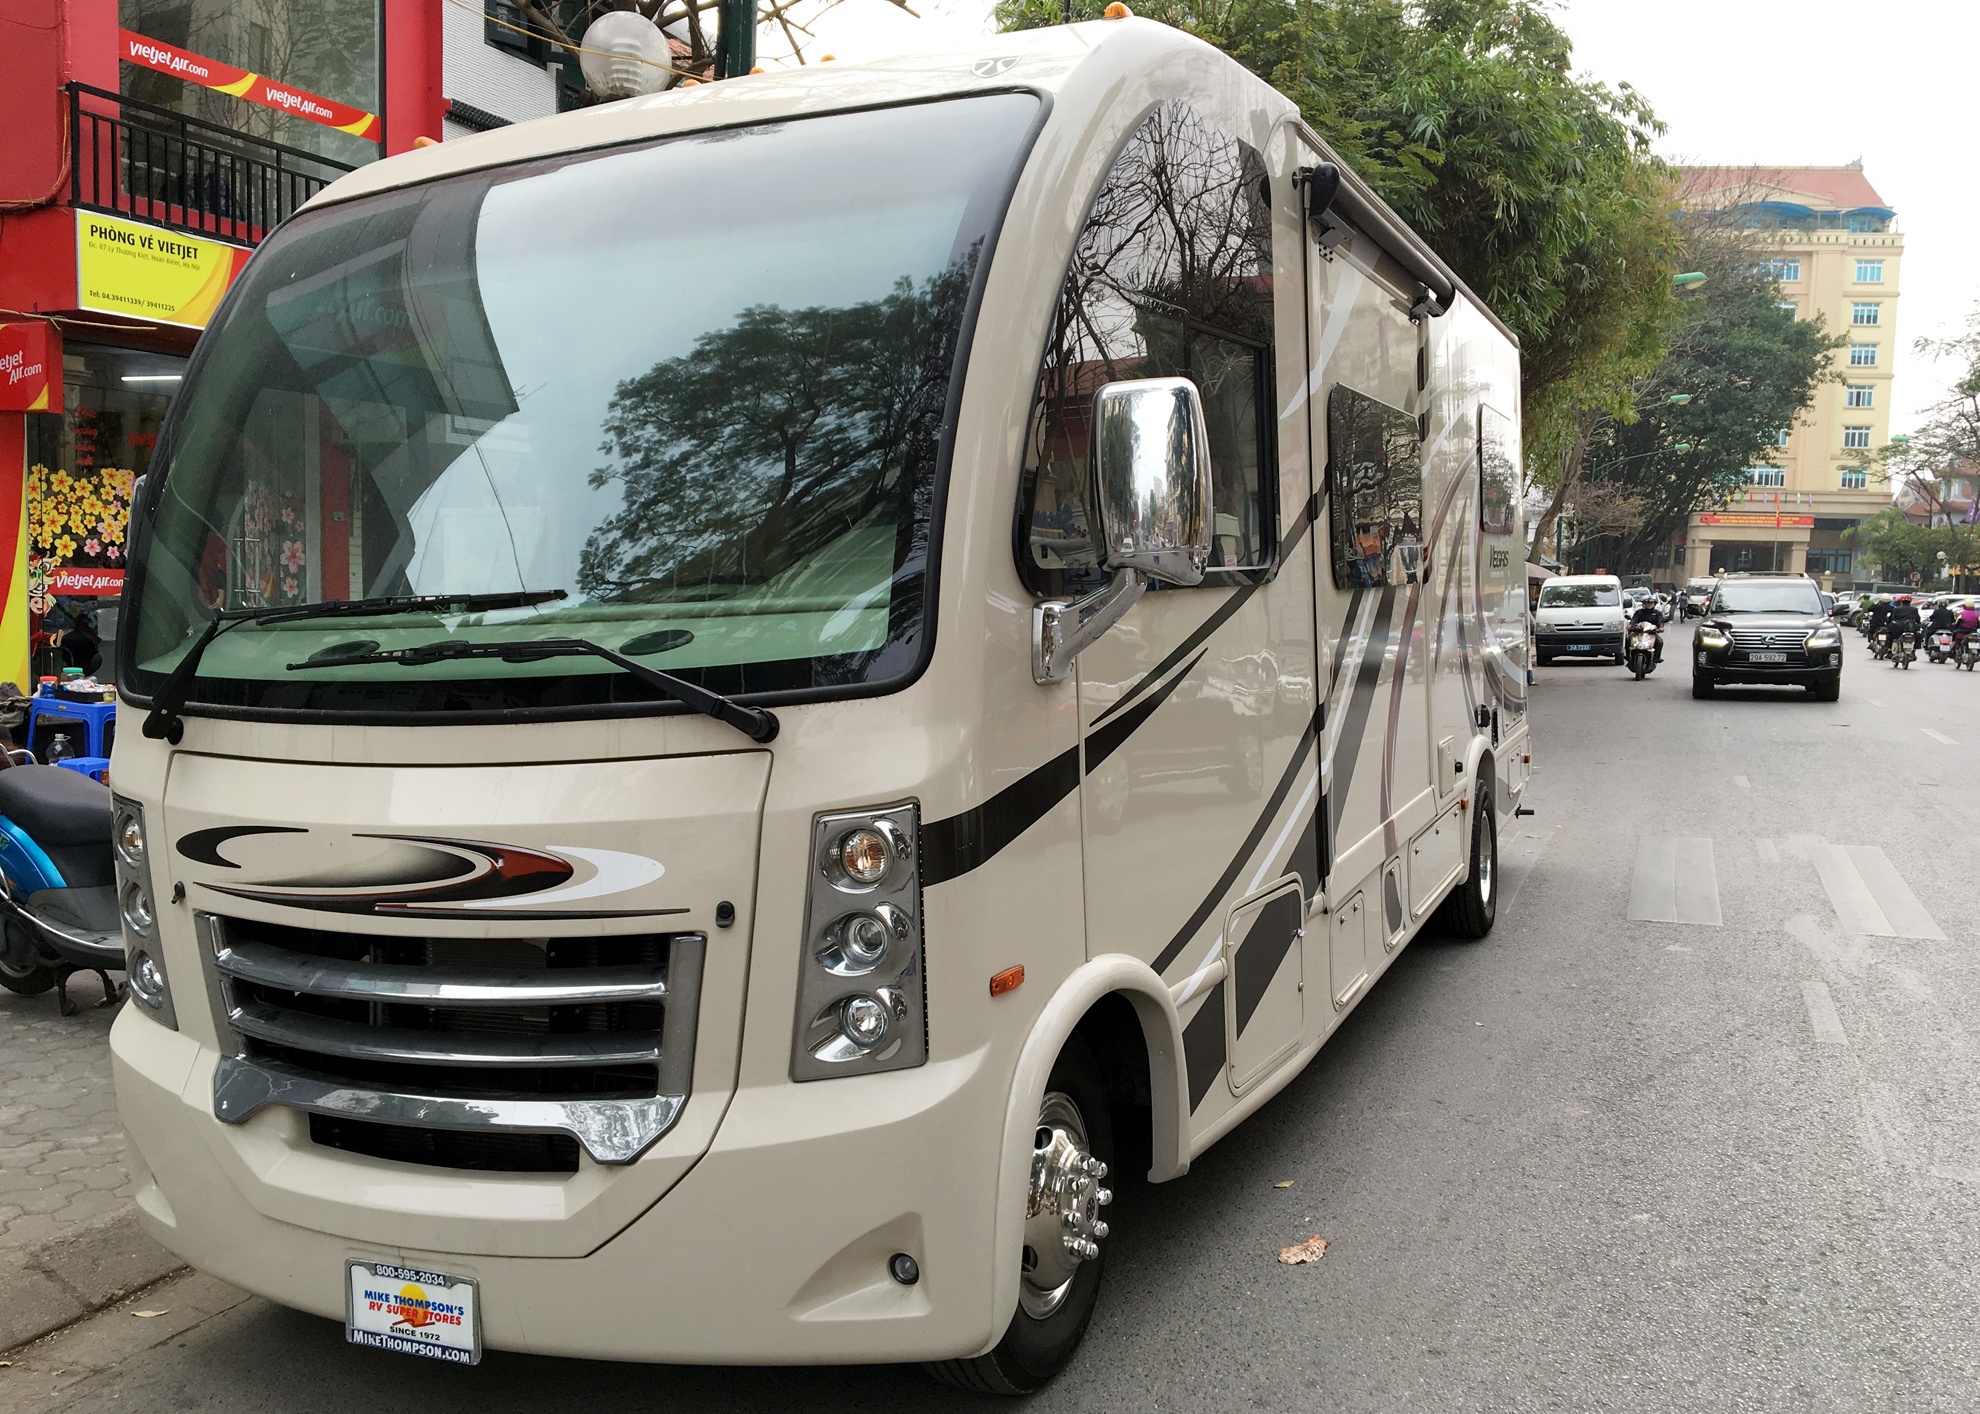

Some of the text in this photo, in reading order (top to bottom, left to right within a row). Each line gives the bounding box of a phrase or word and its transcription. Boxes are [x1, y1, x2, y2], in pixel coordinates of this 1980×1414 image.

[90, 225, 198, 260] PHÒNG VÉ VIETJET
[89, 290, 100, 298] Tel:
[9, 363, 42, 385] Air.com
[1489, 545, 1509, 568] VEGAS
[376, 1264, 445, 1287] 800-595-2034
[364, 1290, 464, 1316] MIKE THOMPSON'S
[368, 1301, 461, 1326] RV SUPER STORES
[389, 1326, 440, 1341] SINCE 1972
